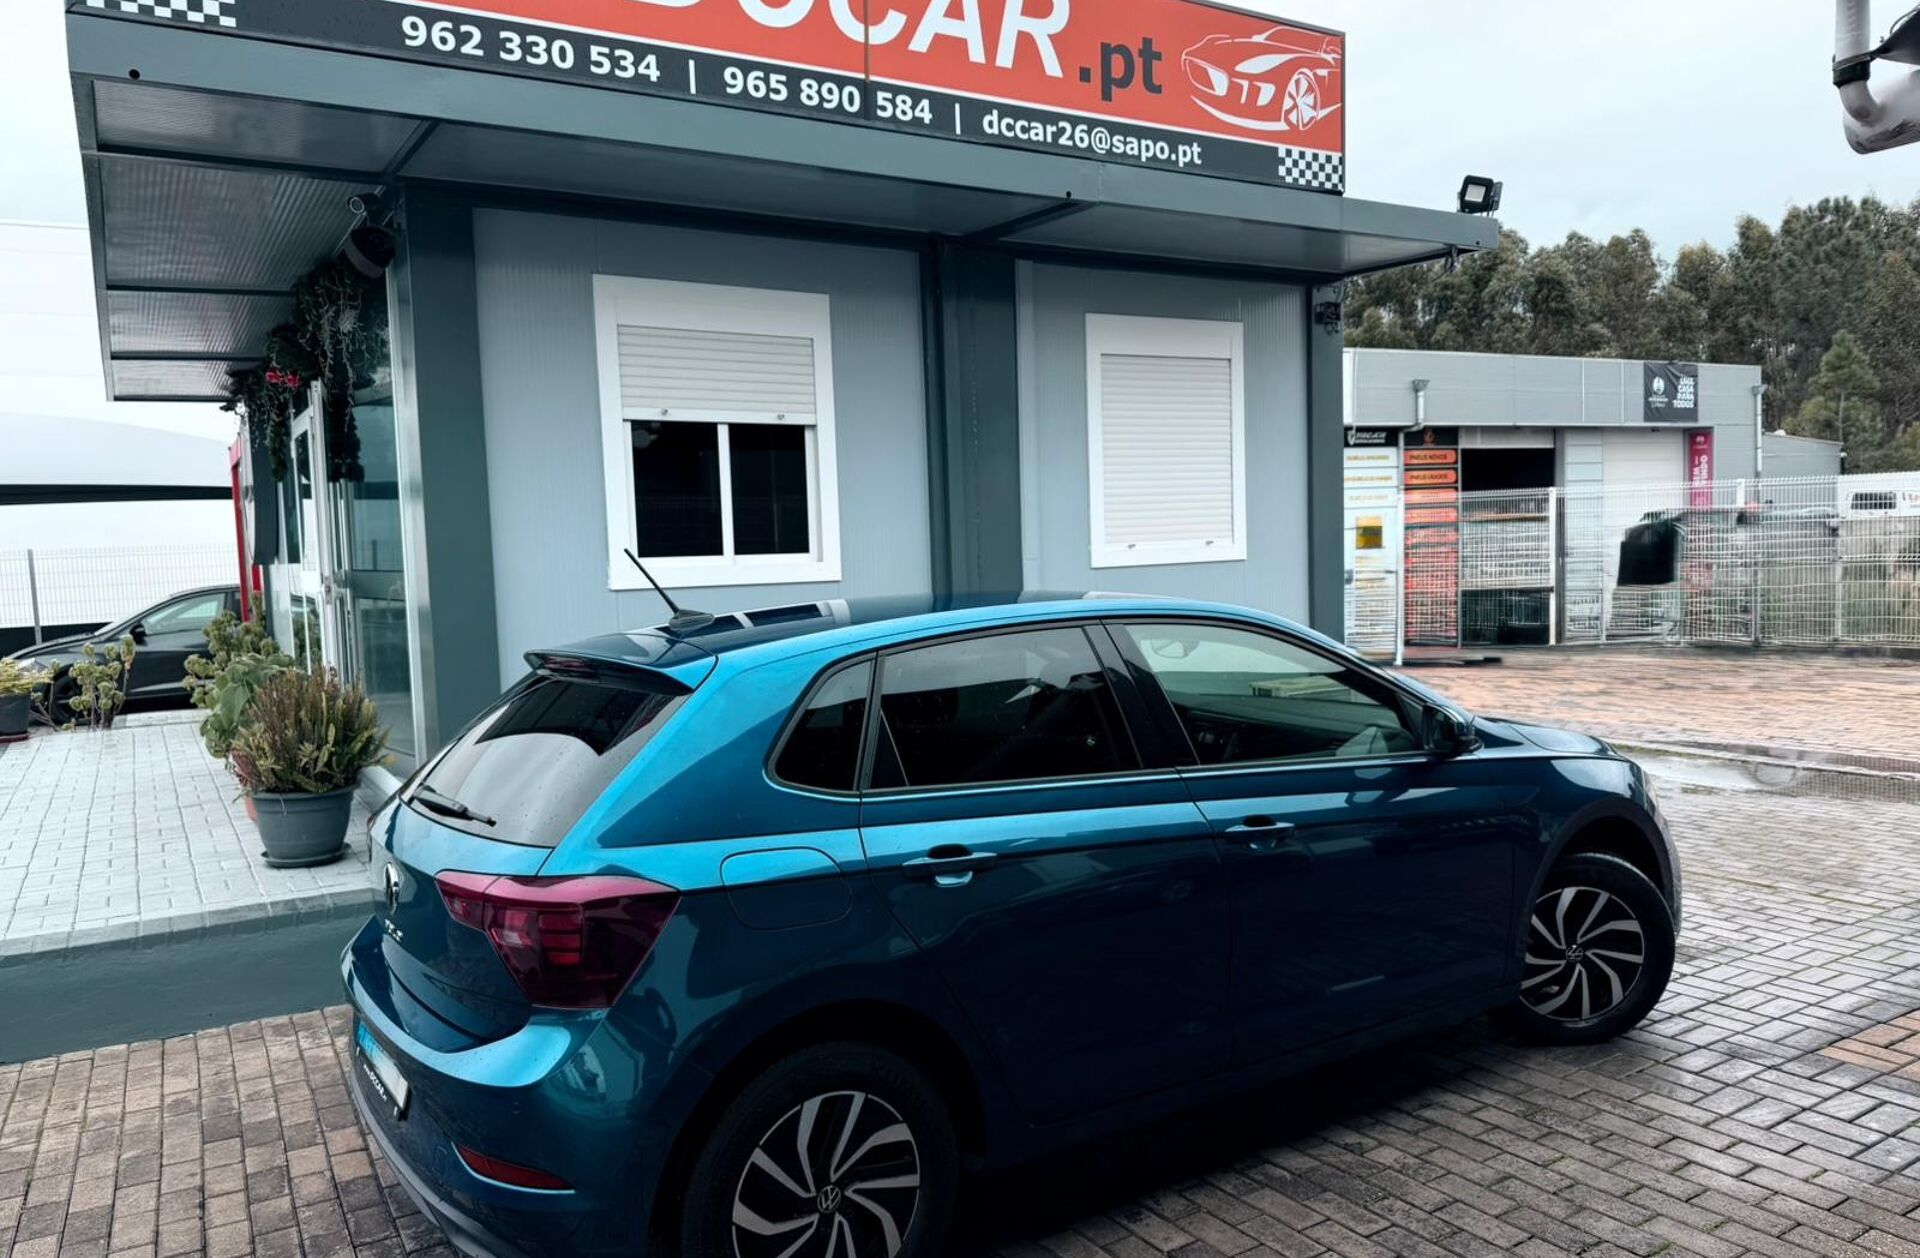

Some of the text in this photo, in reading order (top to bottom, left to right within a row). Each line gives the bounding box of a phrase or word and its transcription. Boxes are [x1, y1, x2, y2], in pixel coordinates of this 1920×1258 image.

[401, 15, 484, 57] 962
[499, 30, 575, 69] 330
[589, 44, 661, 83] 534
[723, 66, 788, 102] 965
[799, 78, 861, 113] 890
[876, 90, 933, 125] 584
[982, 108, 1202, 168] dccar26@sapo.pt
[1672, 400, 1694, 408] TODOS
